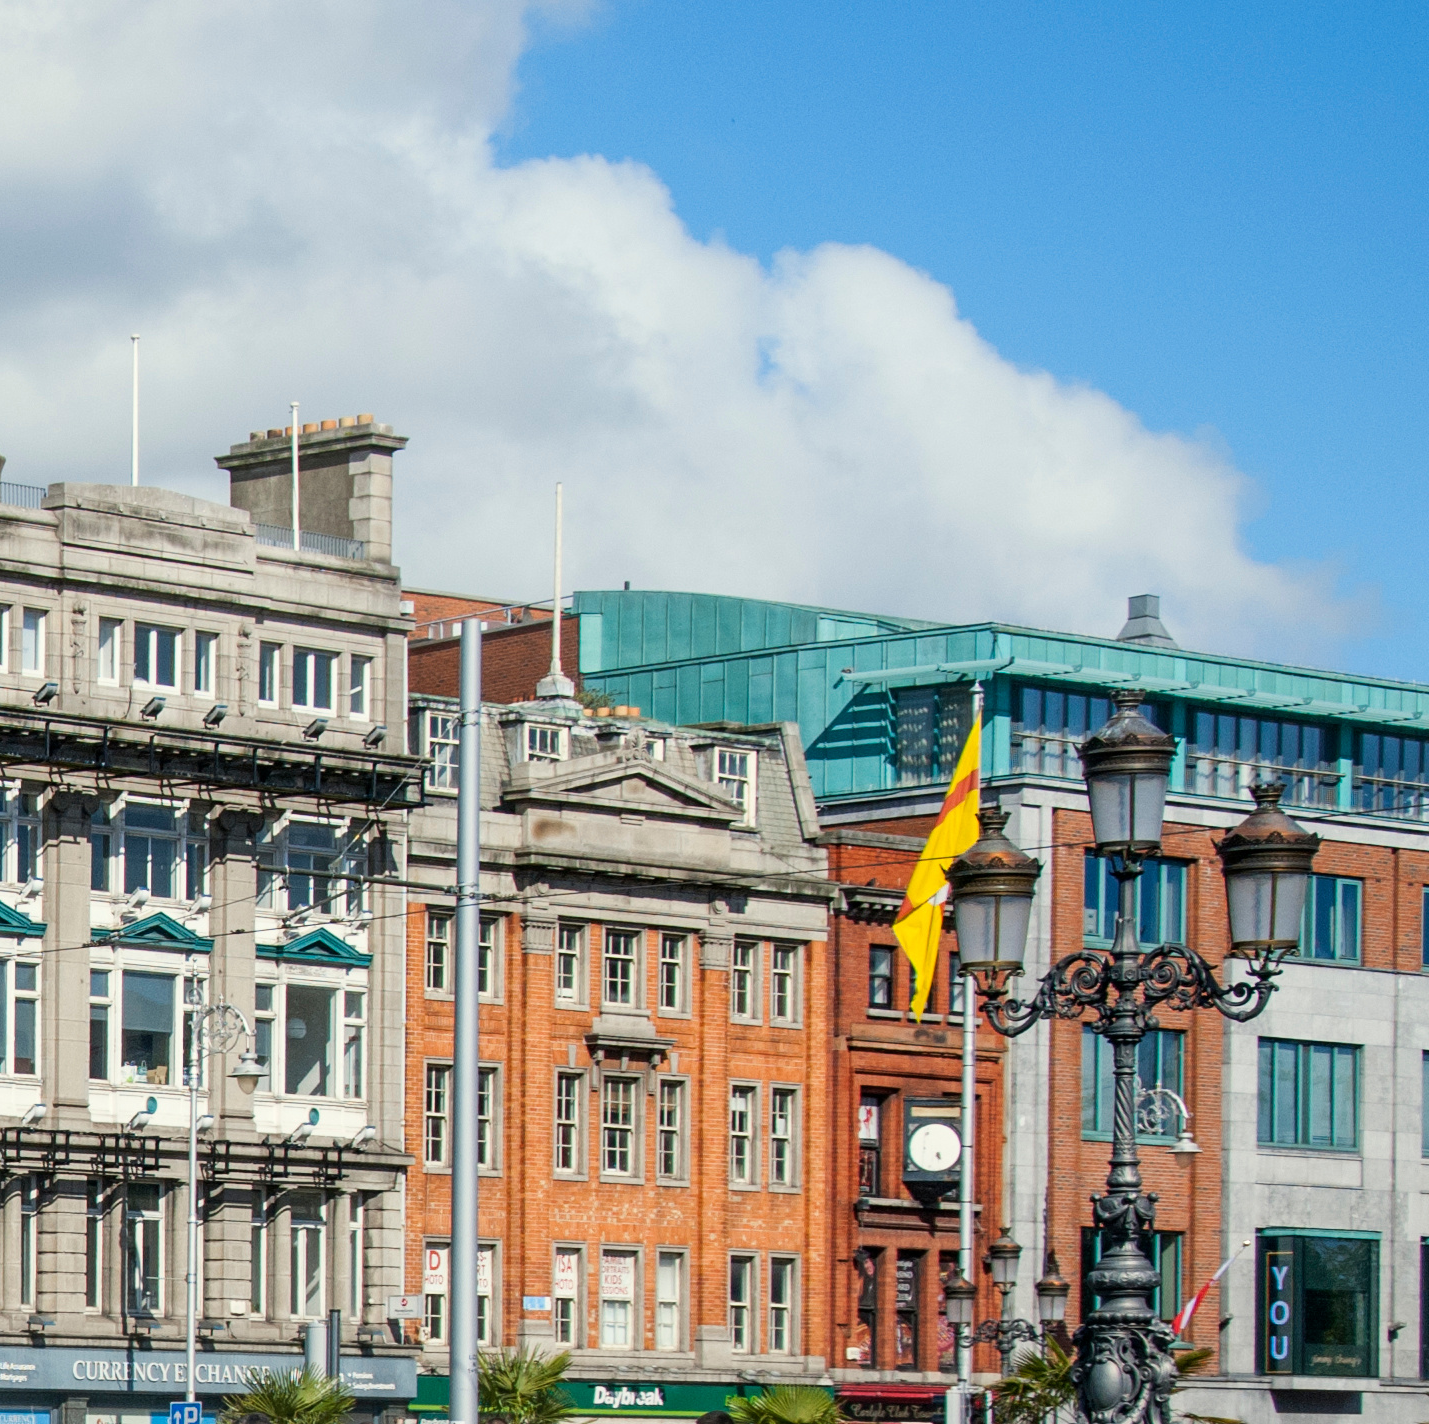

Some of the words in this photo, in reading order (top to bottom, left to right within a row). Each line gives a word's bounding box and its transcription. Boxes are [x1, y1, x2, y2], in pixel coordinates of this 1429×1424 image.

[424, 1274, 444, 1285] HOTO
[555, 1279, 574, 1290] HOTO
[604, 1275, 623, 1285] KIDS
[601, 1286, 629, 1295] ESSIONS
[1269, 1265, 1290, 1360] YOU
[72, 1359, 170, 1383] CURRENCY
[173, 1362, 271, 1386] ECHANGE
[593, 1385, 664, 1409] Daybreak
